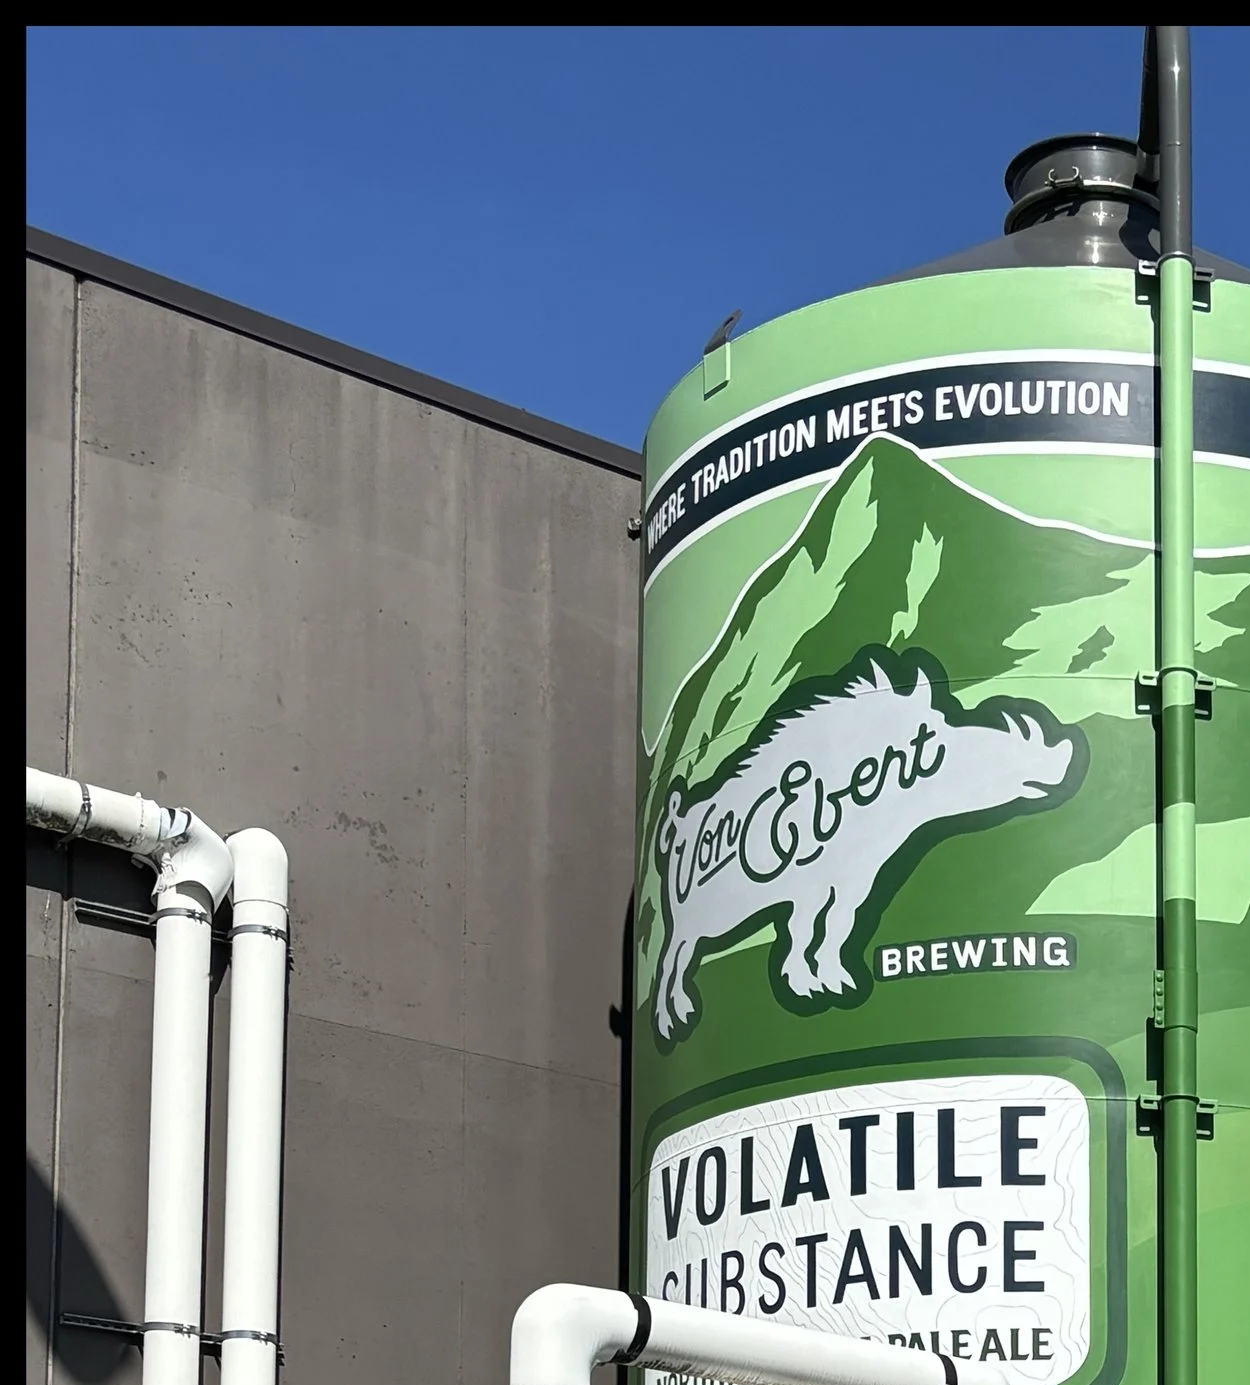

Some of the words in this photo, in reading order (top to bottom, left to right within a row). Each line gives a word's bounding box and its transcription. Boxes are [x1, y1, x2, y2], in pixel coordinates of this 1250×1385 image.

[648, 483, 686, 554] WHERE
[691, 415, 816, 504] TRADITION
[827, 390, 924, 443] MEETS
[935, 380, 1129, 421] EVOLUTION
[675, 803, 741, 904] Von
[740, 723, 945, 883] Ebert
[881, 936, 1070, 977] BREWING
[661, 1106, 1046, 1241] VOLATILE
[979, 1328, 1054, 1361] ALE
